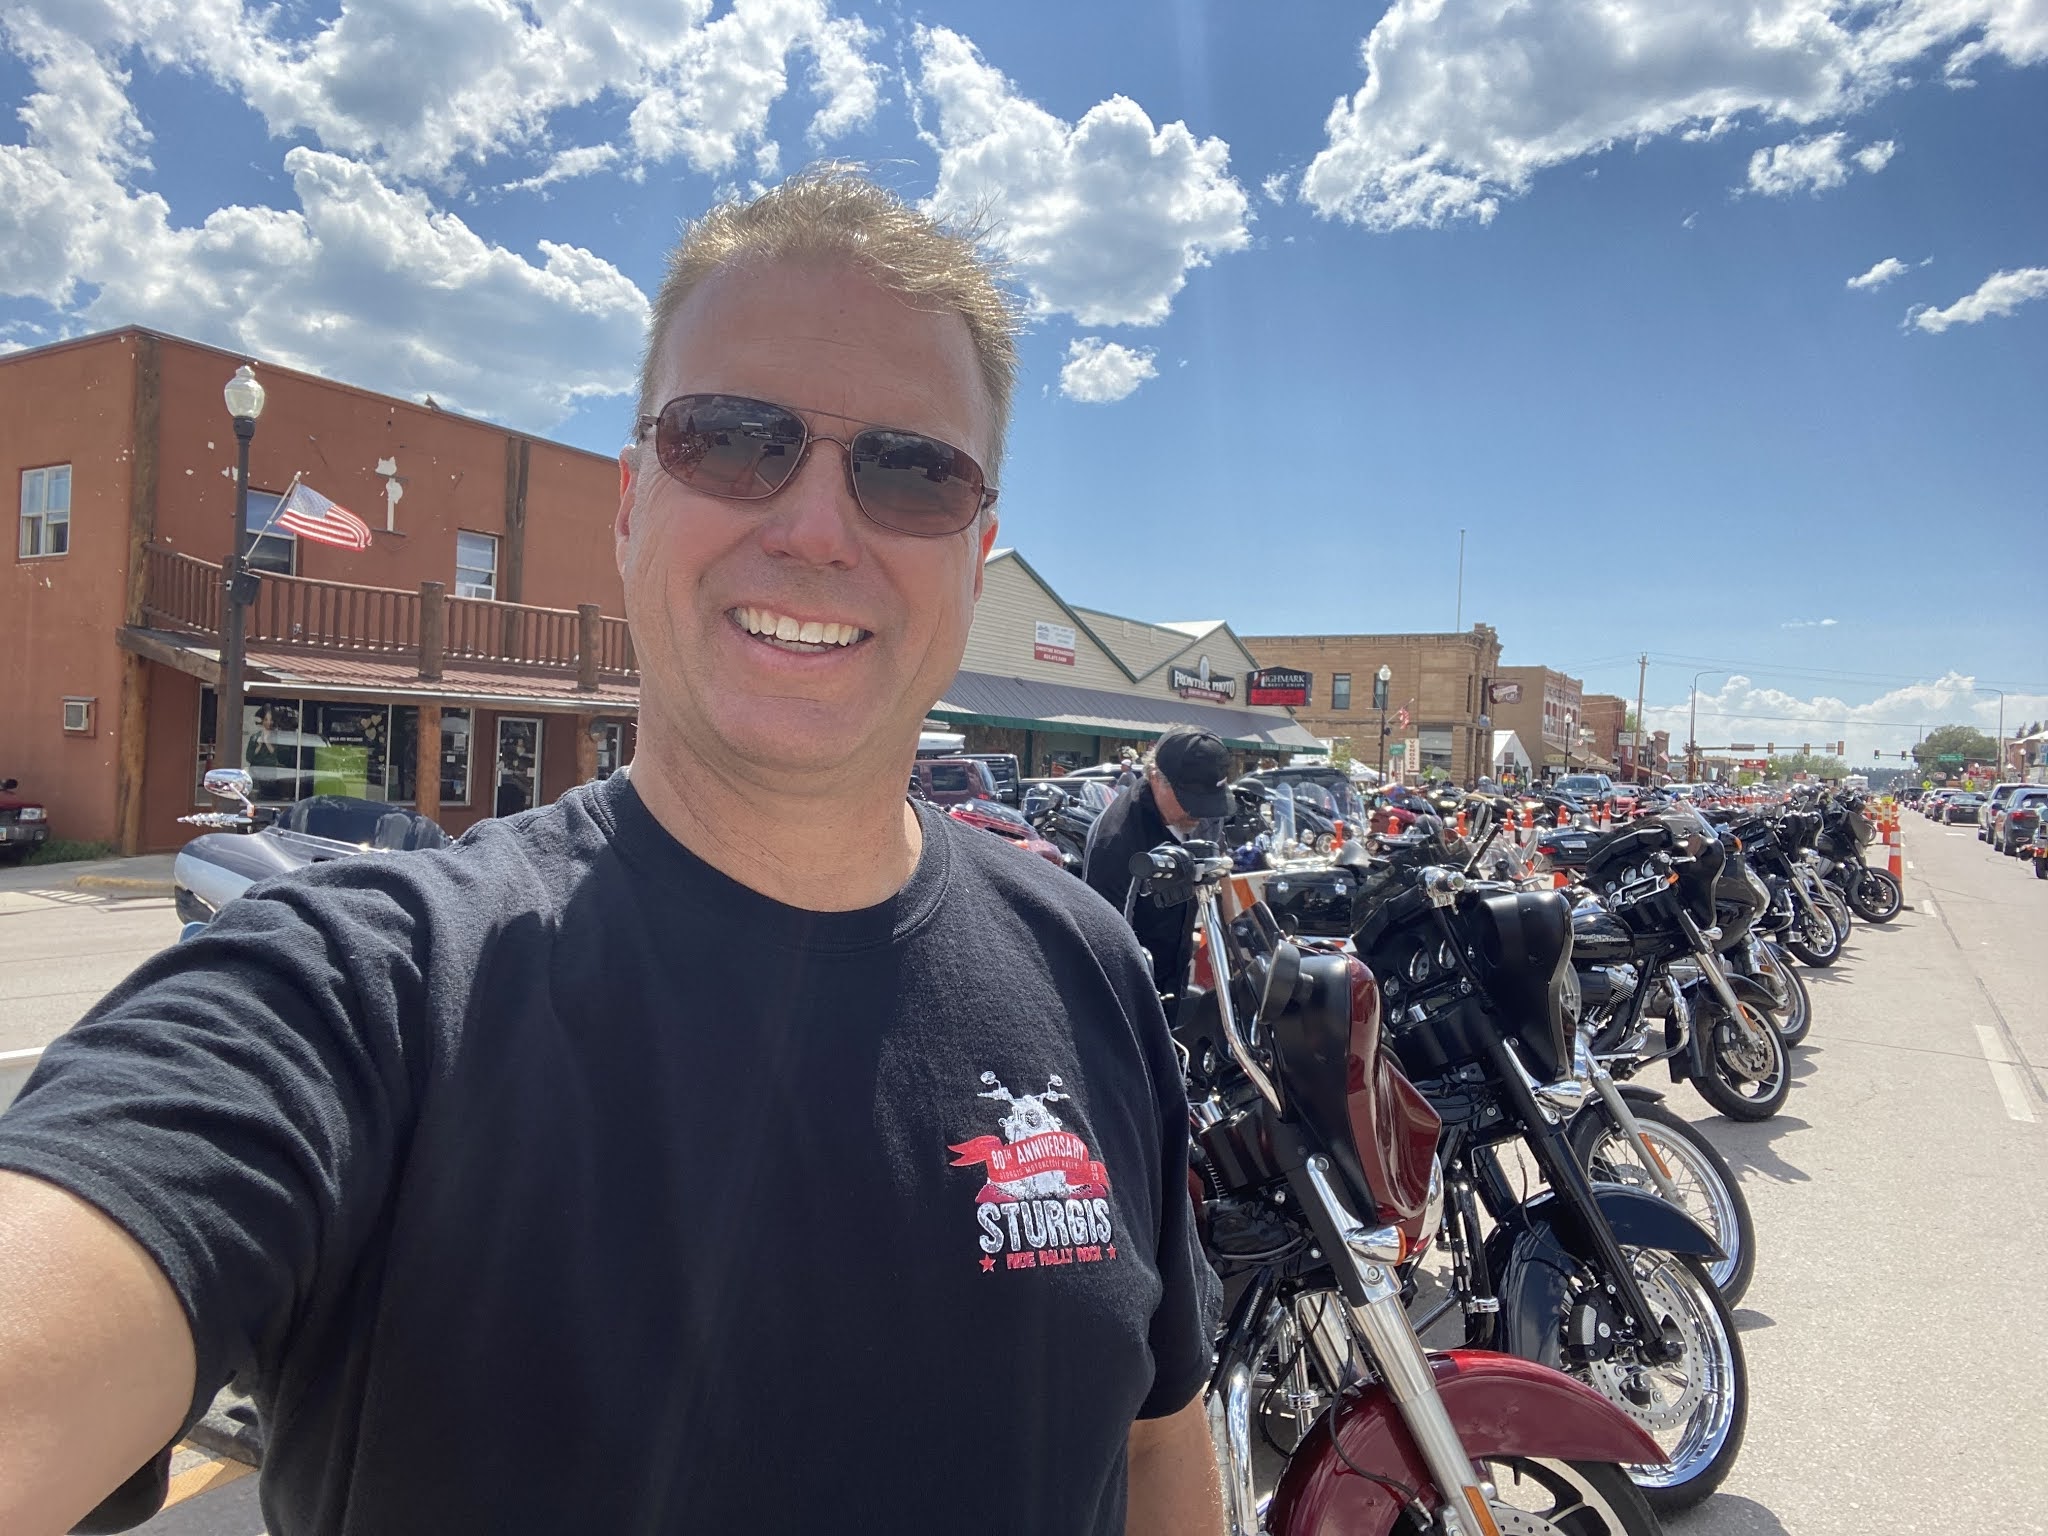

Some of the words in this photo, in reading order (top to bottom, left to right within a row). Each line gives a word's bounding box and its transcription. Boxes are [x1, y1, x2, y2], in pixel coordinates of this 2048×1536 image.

[1174, 669, 1211, 692] FRONTIER
[1212, 679, 1235, 698] PHOTO
[1253, 671, 1305, 687] HIGHMARK
[1016, 1135, 1085, 1165] ANNIVERSARY
[976, 1198, 1113, 1254] STURGIS
[1006, 1251, 1036, 1270] RIDE
[1038, 1247, 1073, 1267] RALLY
[1076, 1245, 1103, 1263] ROCK
